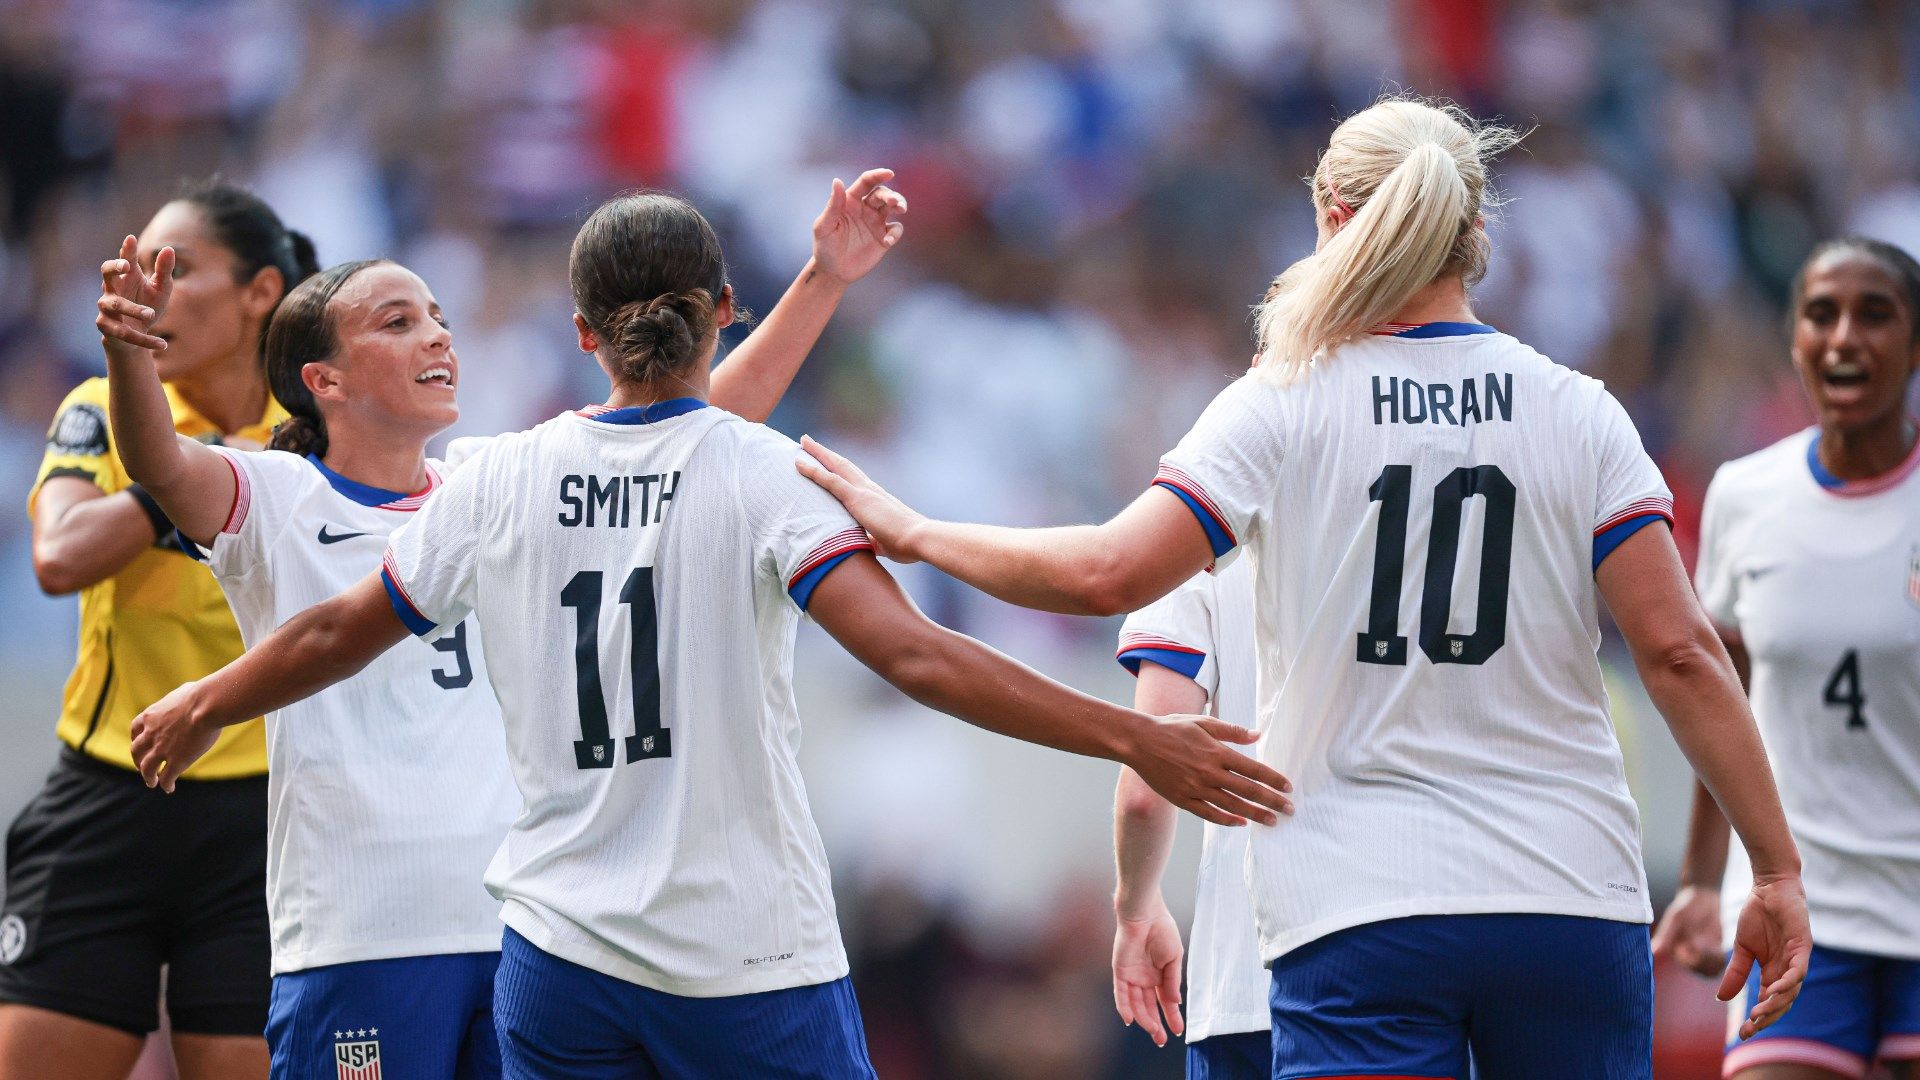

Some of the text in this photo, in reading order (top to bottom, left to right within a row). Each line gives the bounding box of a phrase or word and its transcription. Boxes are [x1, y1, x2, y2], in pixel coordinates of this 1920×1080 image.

[1371, 372, 1513, 427] HORAN
[558, 471, 681, 528] SMITH
[1356, 464, 1516, 665] 10
[560, 566, 672, 769] 11
[1824, 648, 1867, 729] 4
[338, 1044, 377, 1067] USA
